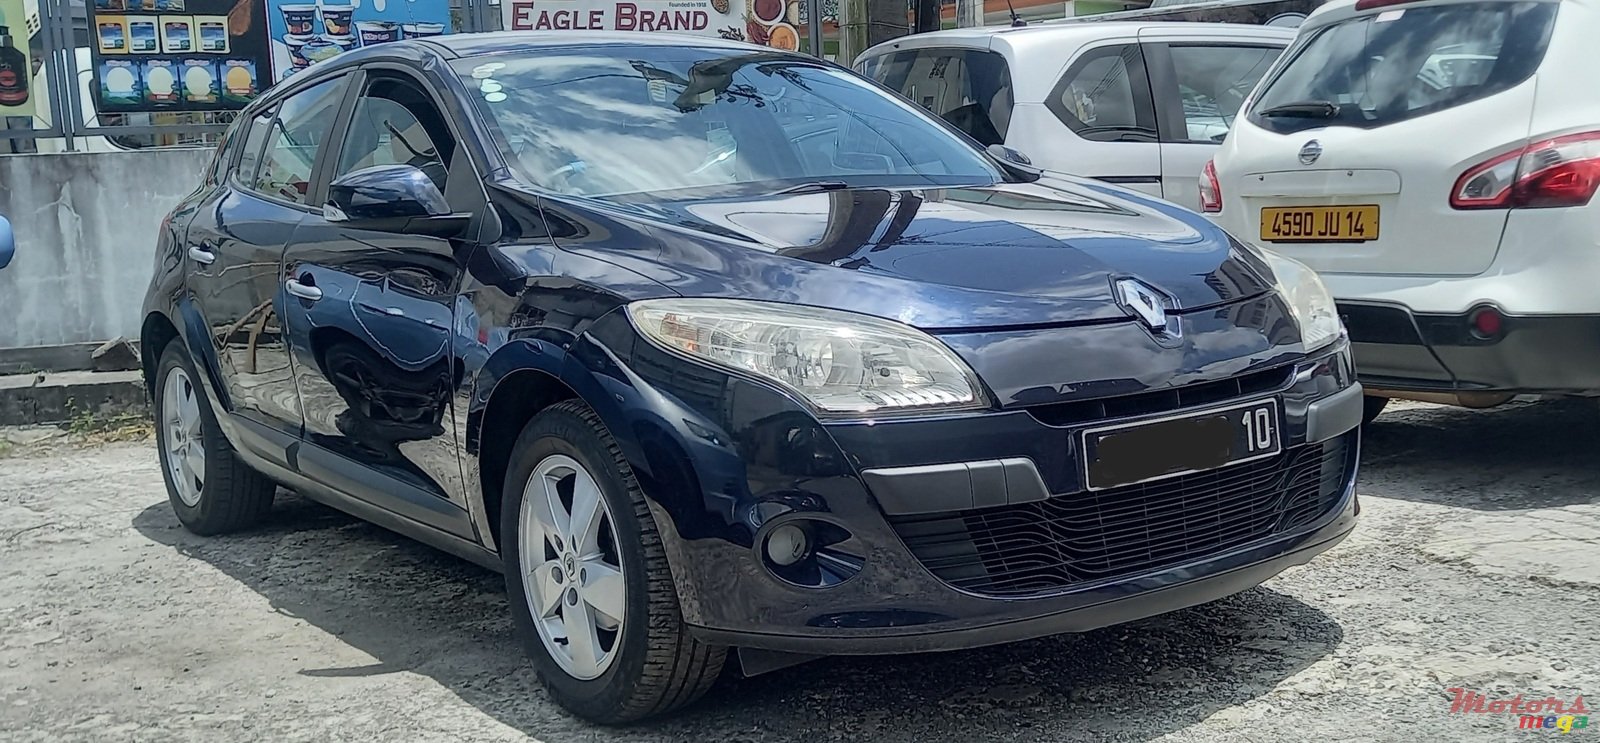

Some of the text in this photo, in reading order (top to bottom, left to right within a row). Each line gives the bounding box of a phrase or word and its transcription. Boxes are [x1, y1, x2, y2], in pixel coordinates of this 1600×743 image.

[512, 1, 708, 31] EAGLE BRAND
[1272, 211, 1365, 237] 4590 JU 14
[1241, 407, 1271, 452] 10
